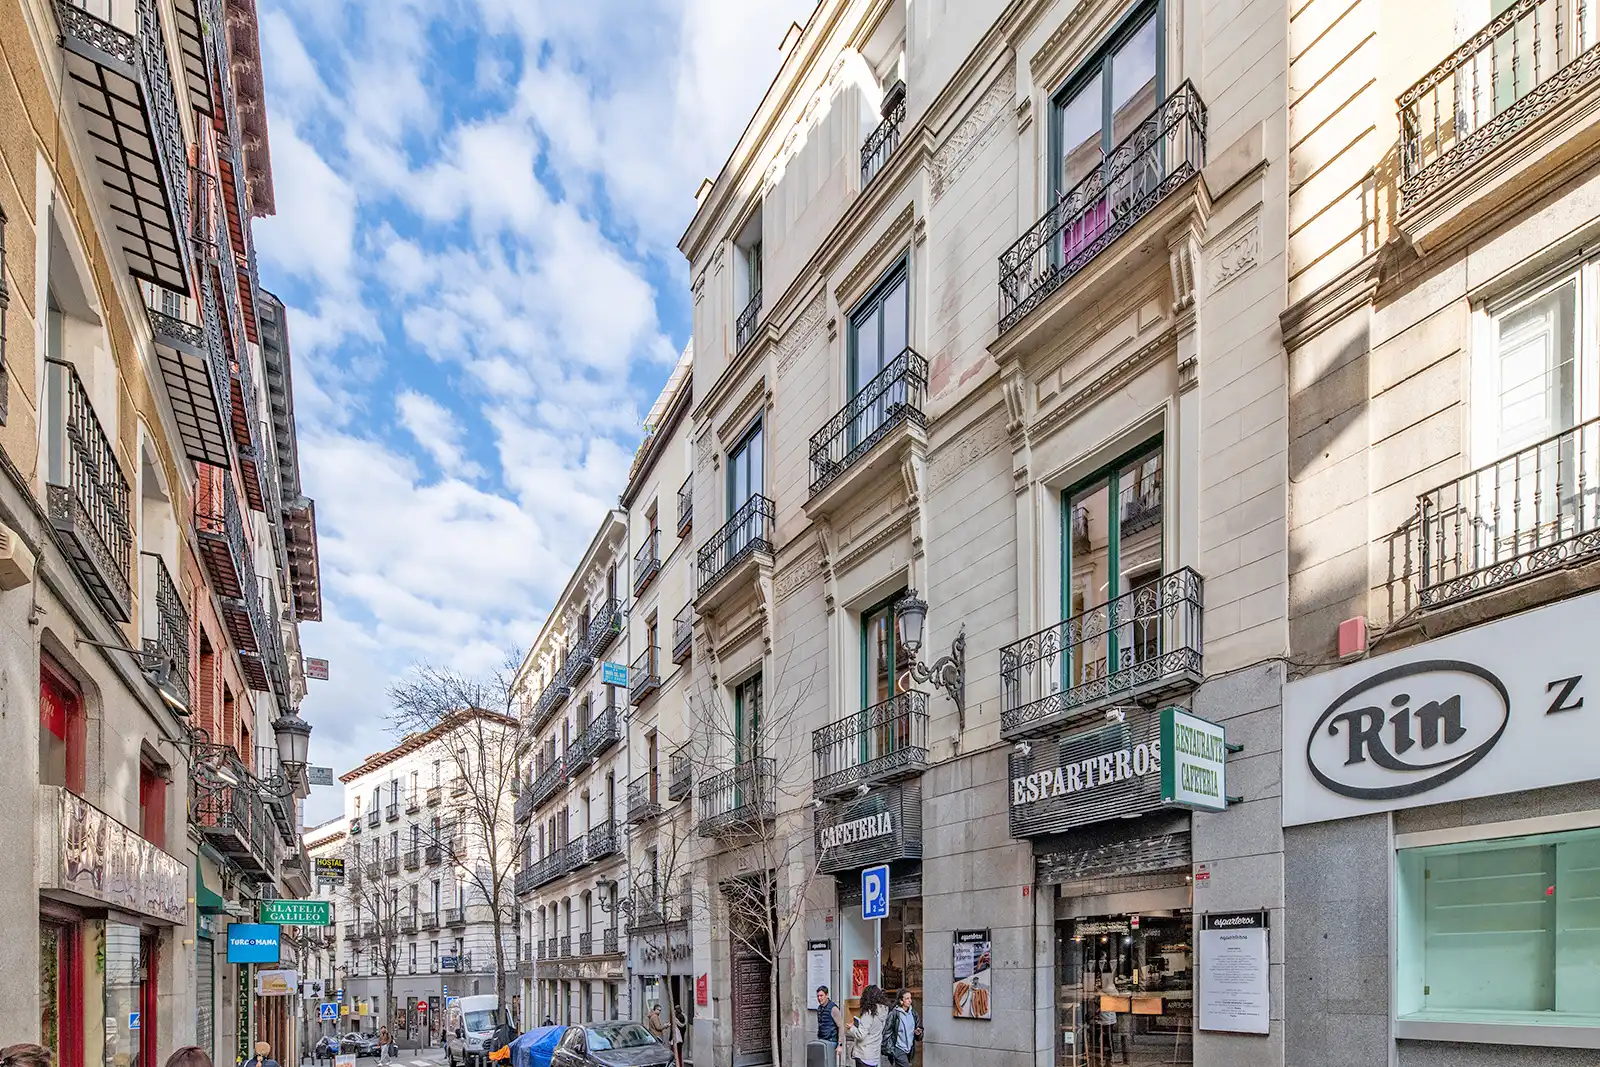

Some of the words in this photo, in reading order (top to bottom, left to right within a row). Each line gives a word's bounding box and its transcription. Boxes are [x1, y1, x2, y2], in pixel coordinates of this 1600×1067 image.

[1175, 723, 1223, 764] RESTAURANTE
[1328, 693, 1468, 770] Rin
[1012, 739, 1161, 805] ESPARTEROS
[1181, 762, 1219, 797] CAFETERIA
[821, 812, 892, 849] CAFETERIA
[317, 858, 343, 866] HOSTAL
[865, 874, 881, 914] P
[1214, 916, 1255, 928] esparteros
[230, 938, 277, 946] TURCOMANA
